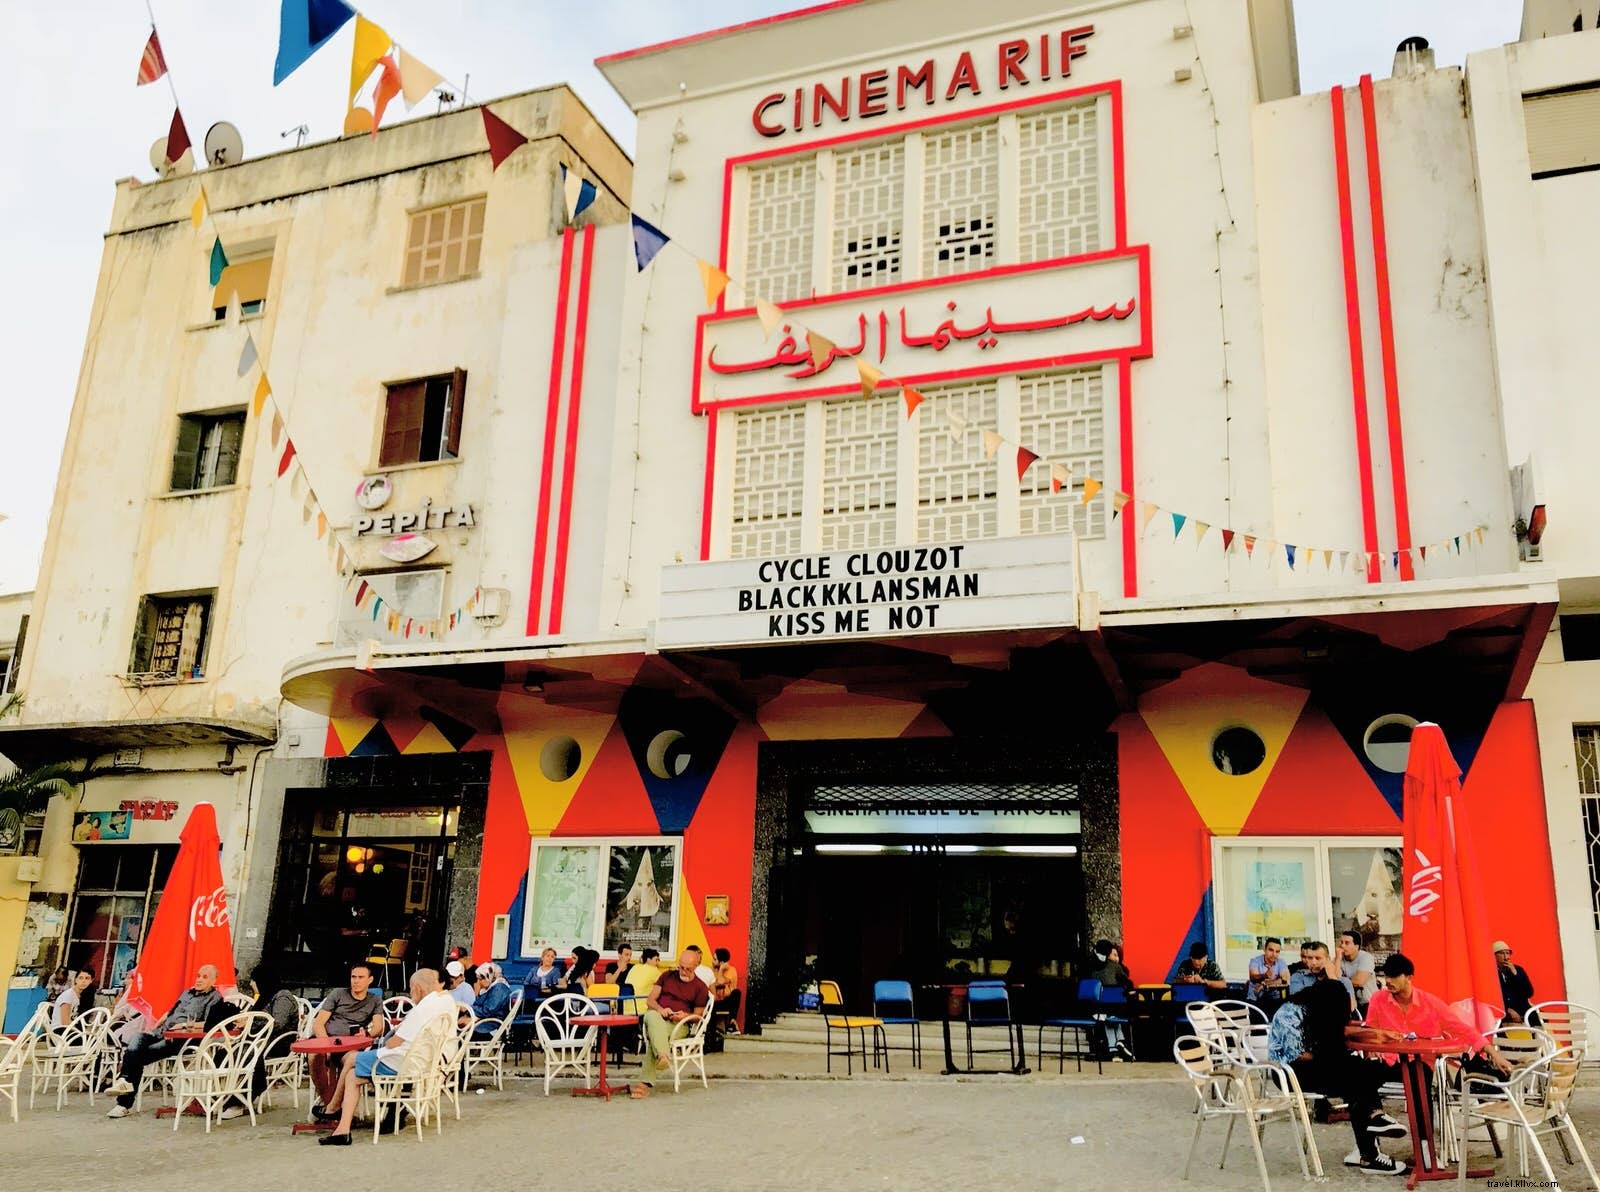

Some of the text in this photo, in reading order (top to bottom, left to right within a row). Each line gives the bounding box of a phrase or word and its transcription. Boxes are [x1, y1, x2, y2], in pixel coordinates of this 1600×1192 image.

[752, 25, 1095, 138] CINEMA RIF
[900, 295, 1136, 351] سينما
[758, 545, 965, 584] CYCLE CLOUZOT
[738, 573, 979, 612] BLACKKKLANSMAN
[768, 604, 940, 637] KISS ME NOT
